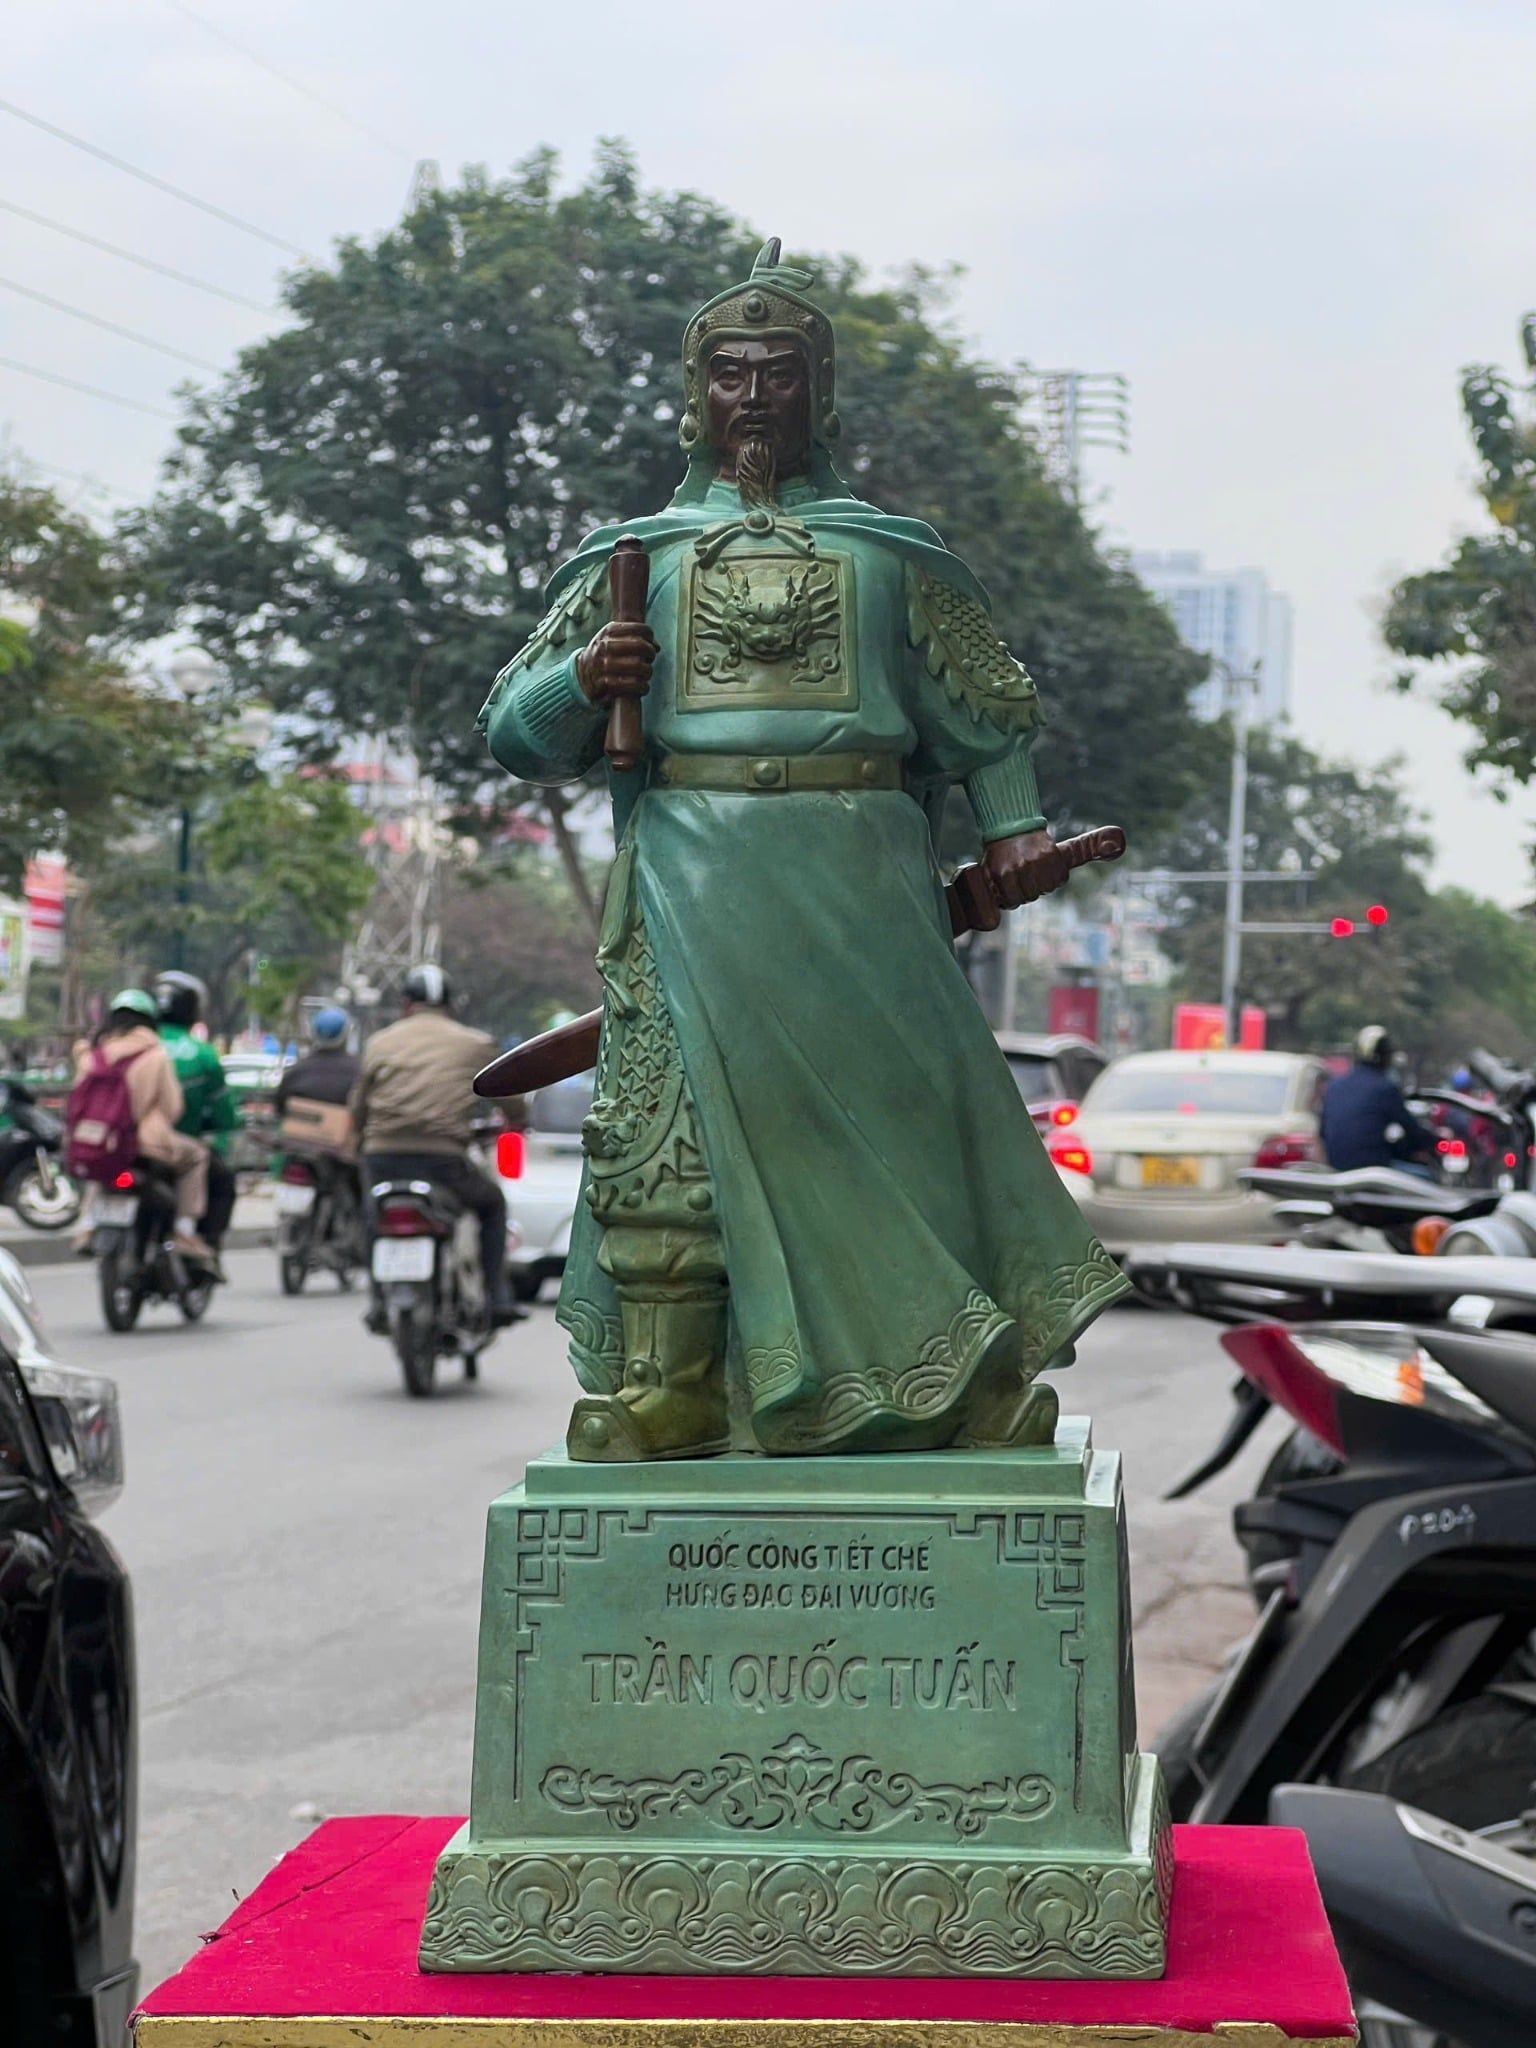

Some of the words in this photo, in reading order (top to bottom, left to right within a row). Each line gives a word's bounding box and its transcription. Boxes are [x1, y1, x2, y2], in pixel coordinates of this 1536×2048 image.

[669, 1529, 740, 1571] QUỐC
[747, 1536, 817, 1570] CÔNG
[824, 1533, 874, 1571] TIẾT
[582, 1636, 713, 1705] TRẦN
[730, 1638, 868, 1713] QUỐC
[882, 1641, 1016, 1712] TUẤN
